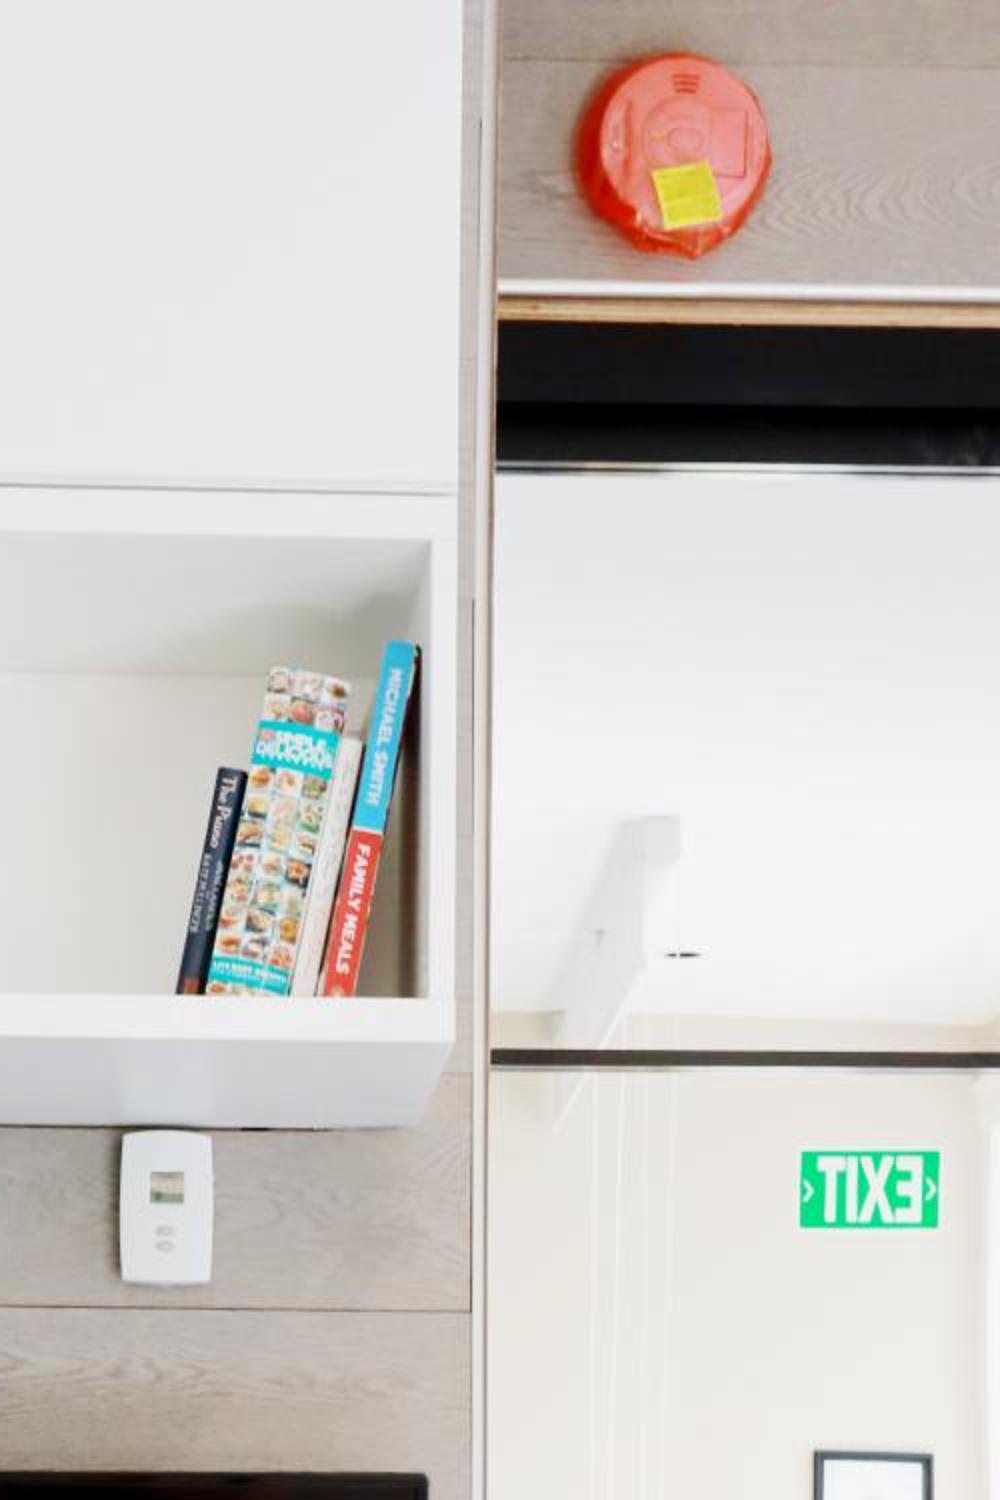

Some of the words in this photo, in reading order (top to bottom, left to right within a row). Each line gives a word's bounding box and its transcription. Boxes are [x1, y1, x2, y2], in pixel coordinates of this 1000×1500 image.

[376, 667, 403, 745] MICHAEL
[218, 777, 237, 804] The
[366, 750, 389, 805] SMITH
[347, 842, 371, 912] FAMILY
[336, 912, 359, 975] MEALS
